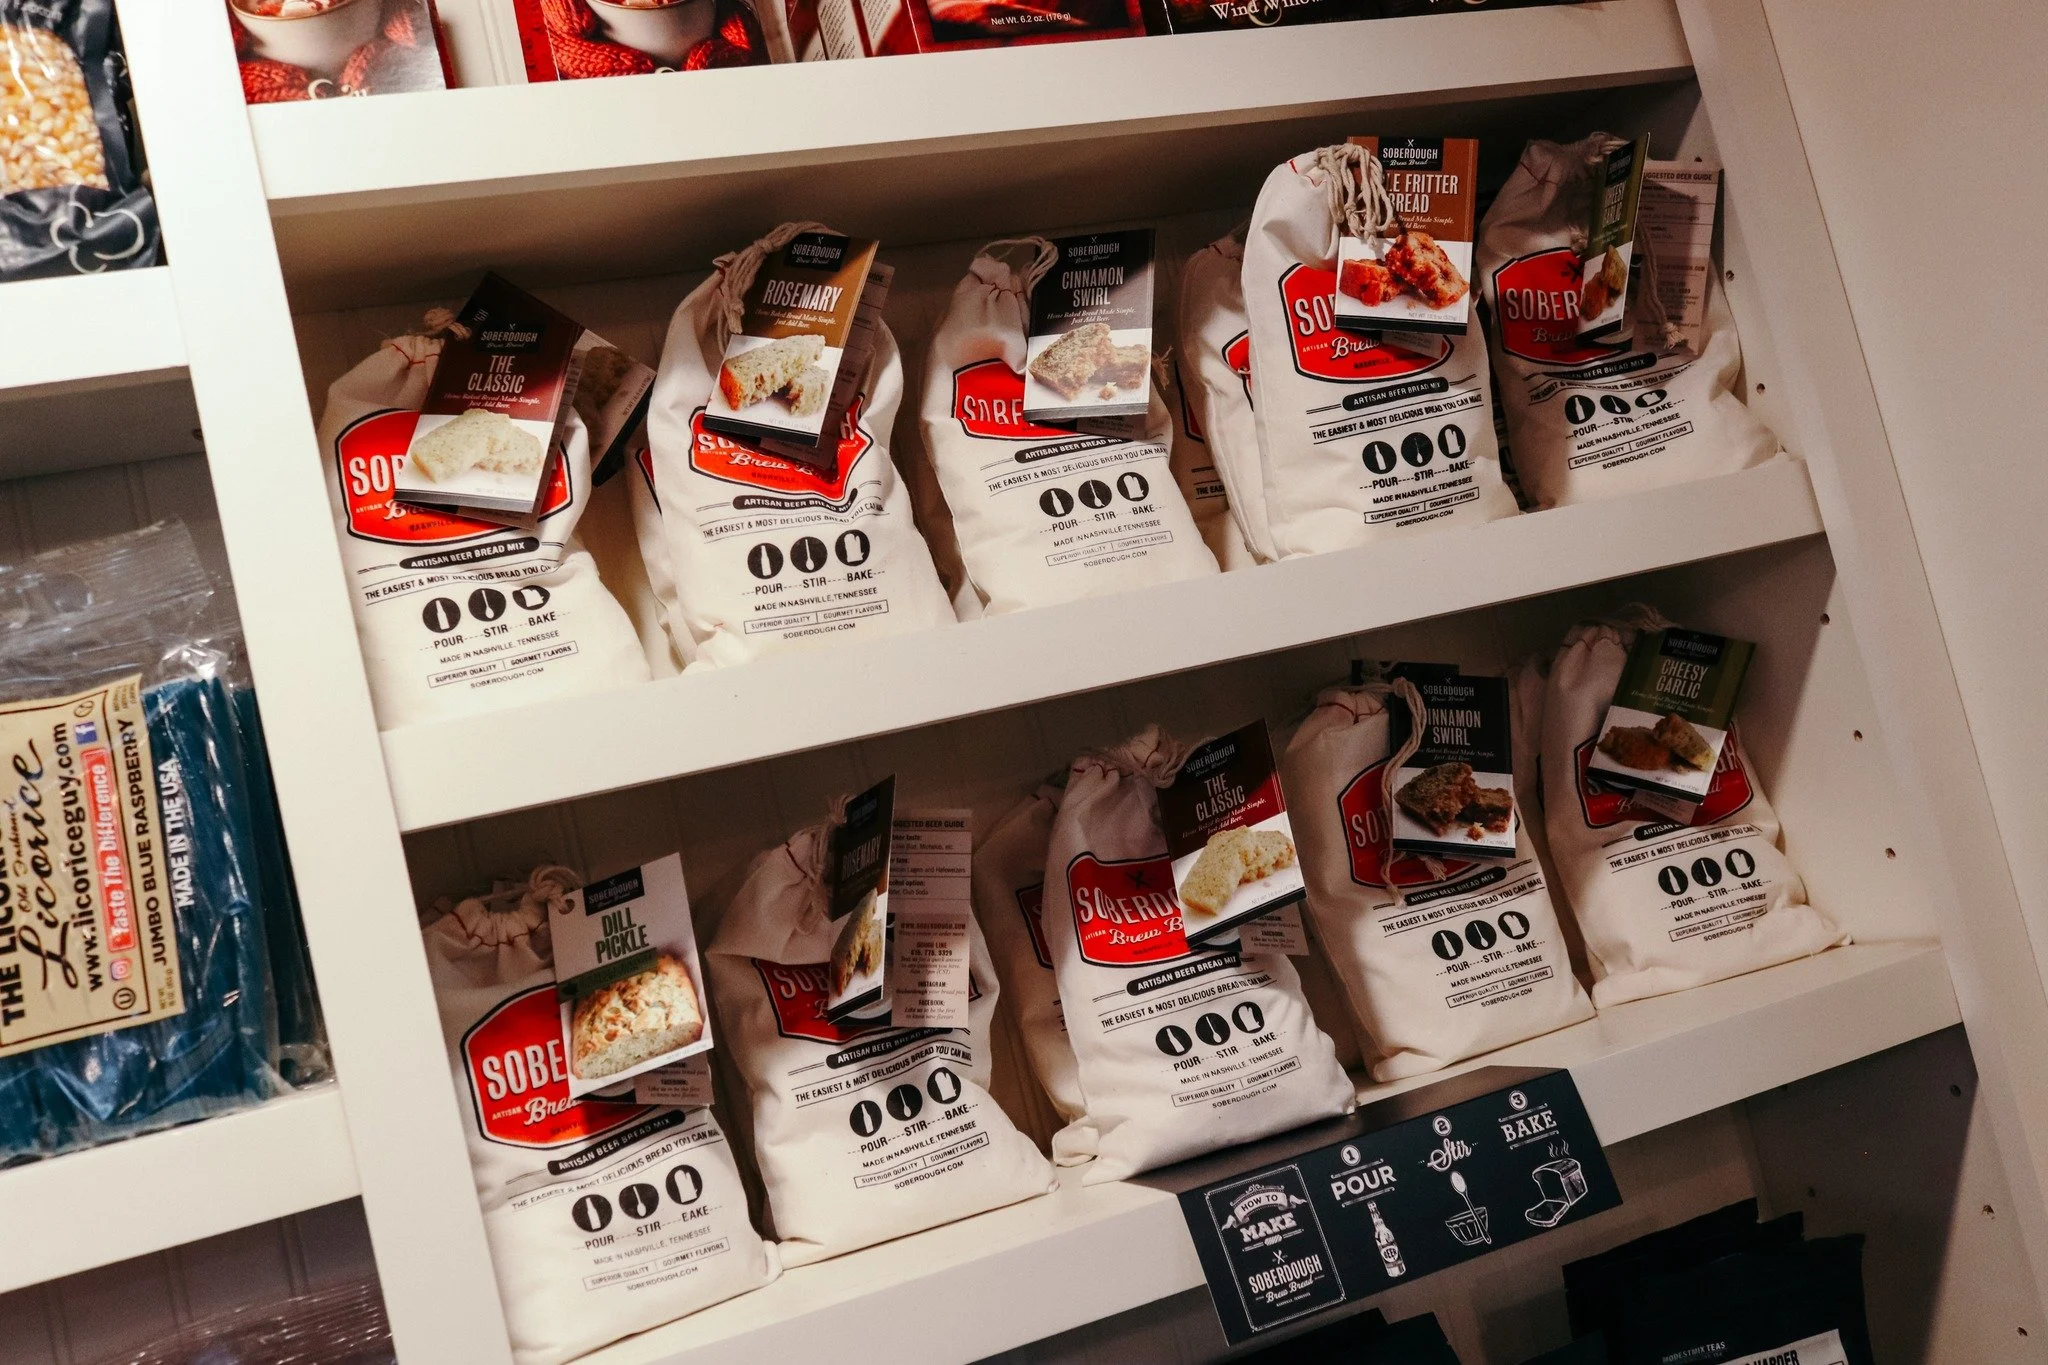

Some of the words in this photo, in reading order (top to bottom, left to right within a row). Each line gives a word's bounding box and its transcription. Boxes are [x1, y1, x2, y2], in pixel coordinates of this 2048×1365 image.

[991, 17, 1005, 25] Net
[1007, 16, 1019, 24] Wt.
[1020, 15, 1032, 23] 6.2
[1034, 14, 1045, 22] oz.
[1046, 12, 1062, 22] (176
[1063, 12, 1071, 21] g)
[1210, 1, 1259, 20] Wind
[1383, 147, 1439, 159] SOBERDOUGH
[1409, 158, 1429, 166] Bread
[1405, 173, 1459, 195] FRITTER
[791, 244, 842, 260] SOBERDOUGH
[1068, 242, 1119, 258] SOBERDOUGH
[1062, 266, 1124, 290] CINNAMON
[763, 279, 843, 313] ROSEMARY
[1073, 286, 1111, 308] SWIRL
[481, 331, 538, 343] SOBERDOUGH
[489, 355, 515, 374] THE
[467, 373, 525, 394] CLASSIC
[1573, 423, 1599, 438] POUR
[1613, 416, 1635, 425] STIR
[1649, 401, 1674, 415] BAKE
[1602, 445, 1666, 470] SOBERDOUGH.COM
[1372, 476, 1399, 490] POUR
[1414, 469, 1435, 482] STIR
[1449, 460, 1470, 473] BAKE
[1052, 518, 1079, 532] POUR
[1094, 510, 1117, 522] STIR
[1132, 503, 1156, 515] BAKE
[1124, 519, 1161, 531] TENNESSEE
[1396, 509, 1454, 528] SOBERDOUGH.COM
[410, 556, 450, 568] ARTISAN
[450, 552, 473, 563] BEER
[474, 545, 505, 557] BREAD
[506, 541, 525, 551] MIX
[755, 583, 784, 596] POUR
[803, 577, 827, 589] STIR
[847, 569, 874, 583] BAKE
[433, 634, 464, 650] POUR
[483, 623, 509, 638] STIR
[527, 611, 556, 627] BAKE
[783, 623, 856, 640] SOBERDOUGH.COM
[1667, 638, 1718, 655] SOBERDOUGH
[434, 671, 468, 683] SUPERIOR
[469, 663, 497, 675] QUALITY
[510, 653, 542, 666] GOURMET
[543, 645, 572, 659] FLAVORS
[470, 667, 545, 689] SOBERDOUGH.COM
[1661, 659, 1709, 682] CHEESY
[1423, 684, 1475, 697] SOBERDOUGH
[1656, 676, 1701, 700] GARLIC
[1426, 708, 1482, 728] INNAMON
[1433, 728, 1471, 746] SWIRL
[1186, 744, 1236, 773] SOBERDOUGH
[117, 719, 150, 840] RASPBERRY
[158, 757, 183, 796] USA
[1204, 772, 1230, 797] THE
[91, 763, 118, 852] Difference
[162, 796, 184, 833] THE
[1196, 785, 1246, 822] CLASSIC
[53, 722, 103, 992] www.licoriceguy.com
[167, 833, 190, 853] IN
[12, 738, 79, 990] Licorice
[104, 855, 123, 888] The
[140, 847, 156, 893] BLUE
[170, 854, 195, 907] MADE
[588, 878, 640, 904] SOBERDOUGH
[1670, 896, 1695, 909] POUR
[1708, 887, 1729, 899] STIR
[1741, 878, 1763, 891] BAKE
[108, 889, 130, 937] Taste
[601, 906, 637, 937] DILL
[146, 896, 167, 966] JUMBO
[595, 924, 650, 964] PICKLE
[1108, 927, 1162, 945] Brew
[1446, 961, 1470, 974] POUR
[1482, 950, 1503, 964] STIR
[1515, 939, 1537, 953] BAKE
[1137, 973, 1174, 992] ARTISAN
[1175, 966, 1196, 979] BEER
[1197, 959, 1223, 973] BREAD
[837, 1047, 871, 1063] ARTISAN
[872, 1041, 893, 1054] BEER
[1173, 1056, 1202, 1072] POUR
[1216, 1045, 1239, 1059] STIR
[1252, 1031, 1277, 1047] BAKE
[1178, 1090, 1210, 1103] SUPERIOR
[1210, 1083, 1236, 1095] QUALITY
[1246, 1070, 1273, 1084] GOURMET
[1274, 1060, 1297, 1075] FLAVORS
[1212, 1083, 1278, 1109] SOBERDOUGH.COM
[860, 1135, 889, 1154] POUR
[903, 1119, 928, 1137] STIR
[944, 1103, 970, 1121] BAKE
[1500, 1109, 1557, 1143] BAKE
[558, 1152, 595, 1170] ARTISAN
[596, 1139, 620, 1156] BEER
[621, 1124, 651, 1143] BREAD
[653, 1118, 670, 1129] MIX
[1427, 1138, 1472, 1171] Stir
[894, 1160, 965, 1190] SOBERDOUGH.COM
[1331, 1164, 1398, 1201] POUR
[1241, 1196, 1262, 1212] HOW
[1266, 1194, 1278, 1202] TO
[584, 1234, 615, 1250] POUR
[636, 1221, 662, 1236] STIR
[1240, 1211, 1297, 1243] MAKE
[1248, 1254, 1324, 1294] SOBERDOUGH
[1265, 1289, 1289, 1303] Brew
[1288, 1277, 1314, 1295] Bread
[1706, 1341, 1726, 1352] TEAS
